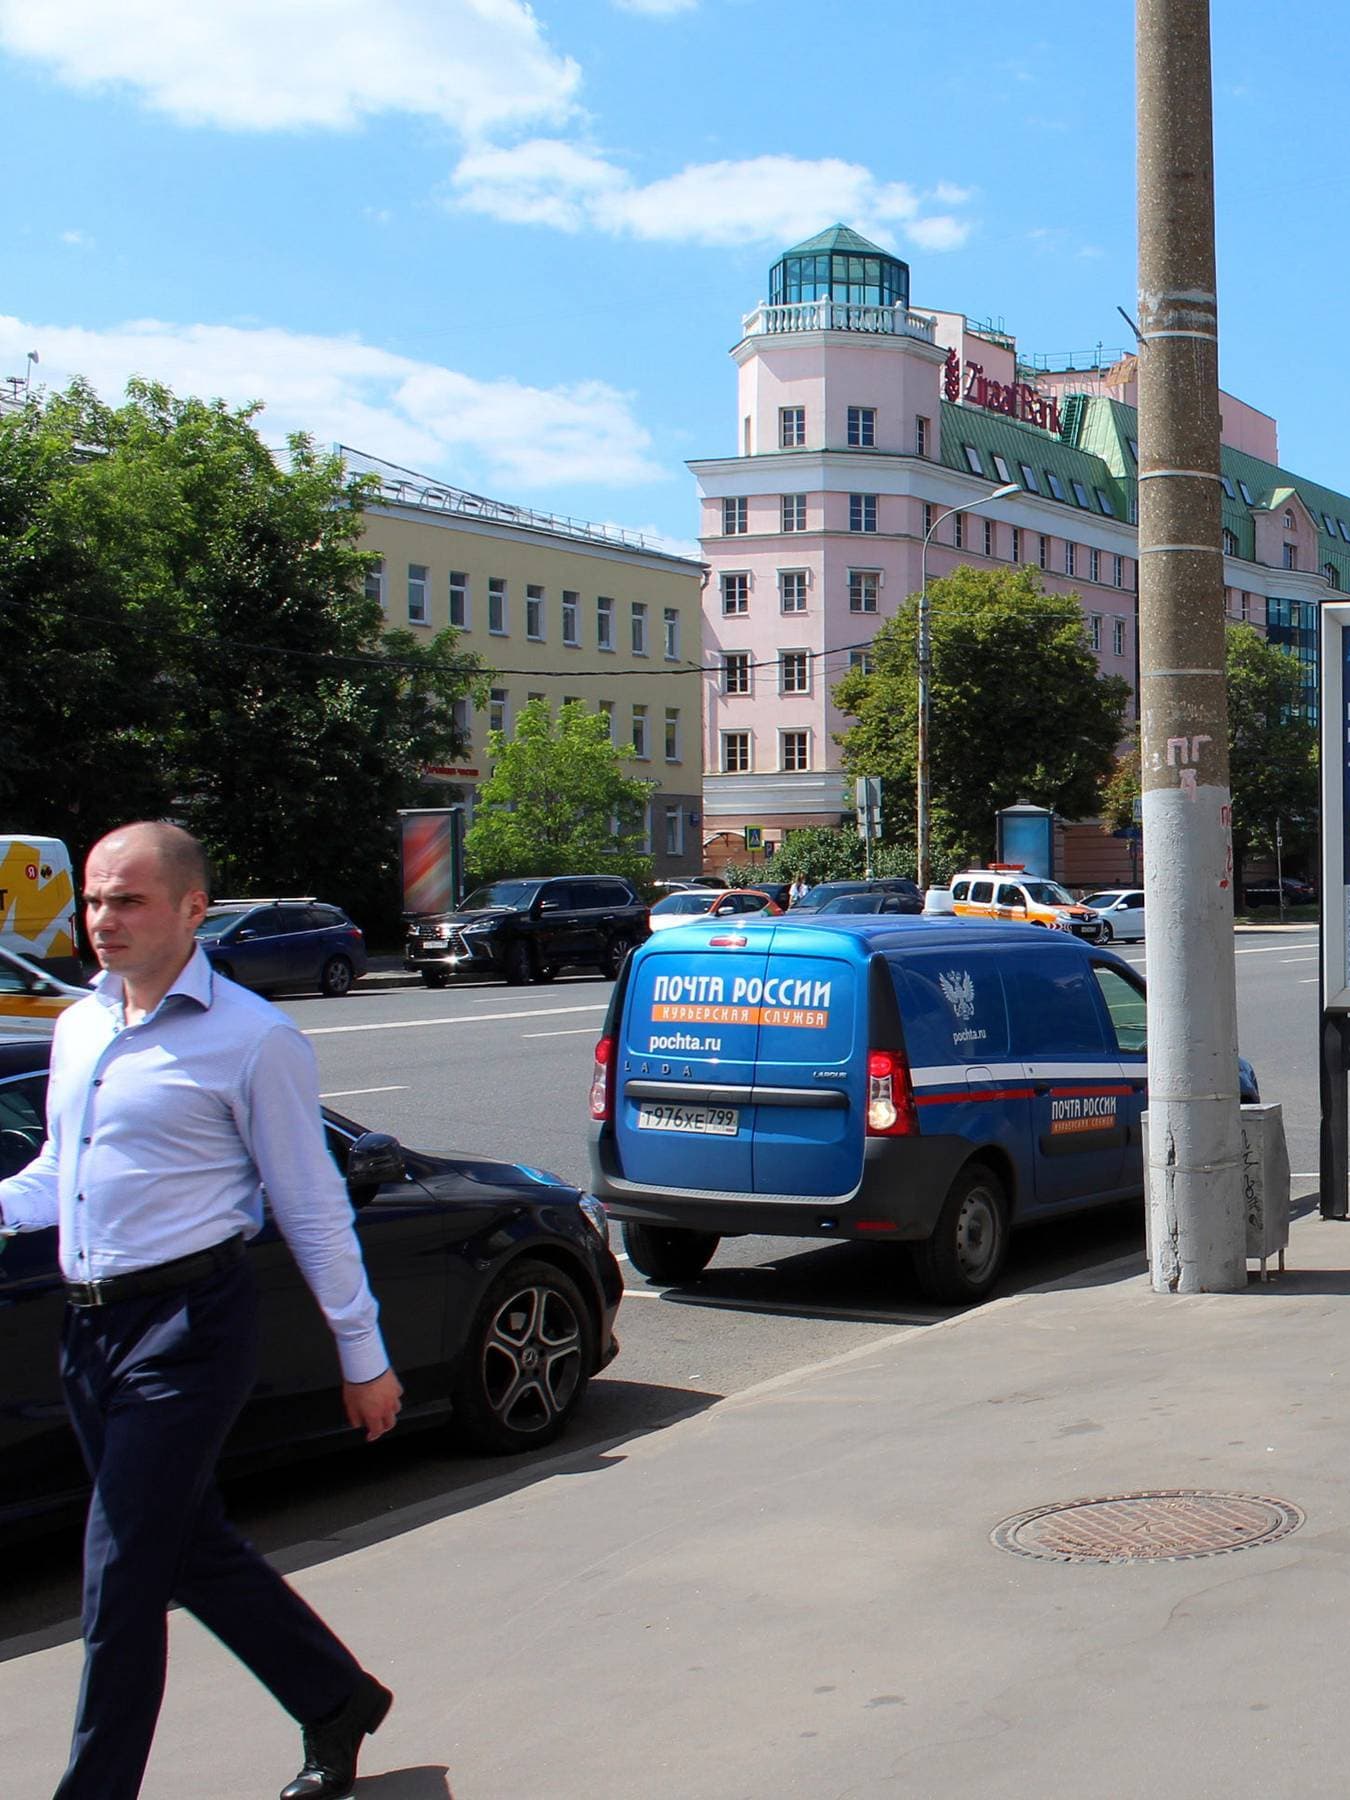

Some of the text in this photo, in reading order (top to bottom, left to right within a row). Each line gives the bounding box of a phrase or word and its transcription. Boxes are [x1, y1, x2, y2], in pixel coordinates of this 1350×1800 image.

[653, 975, 832, 1008] ПОЧТА РОССИИ
[662, 1007, 825, 1025] КУРЬЕРСКАЯ СЛУЖБА
[649, 1032, 721, 1053] pochta.ru
[953, 1028, 987, 1045] pochta.ru
[624, 1060, 692, 1078] LADA
[1051, 1096, 1117, 1120] ПОЧТА РОССИИ
